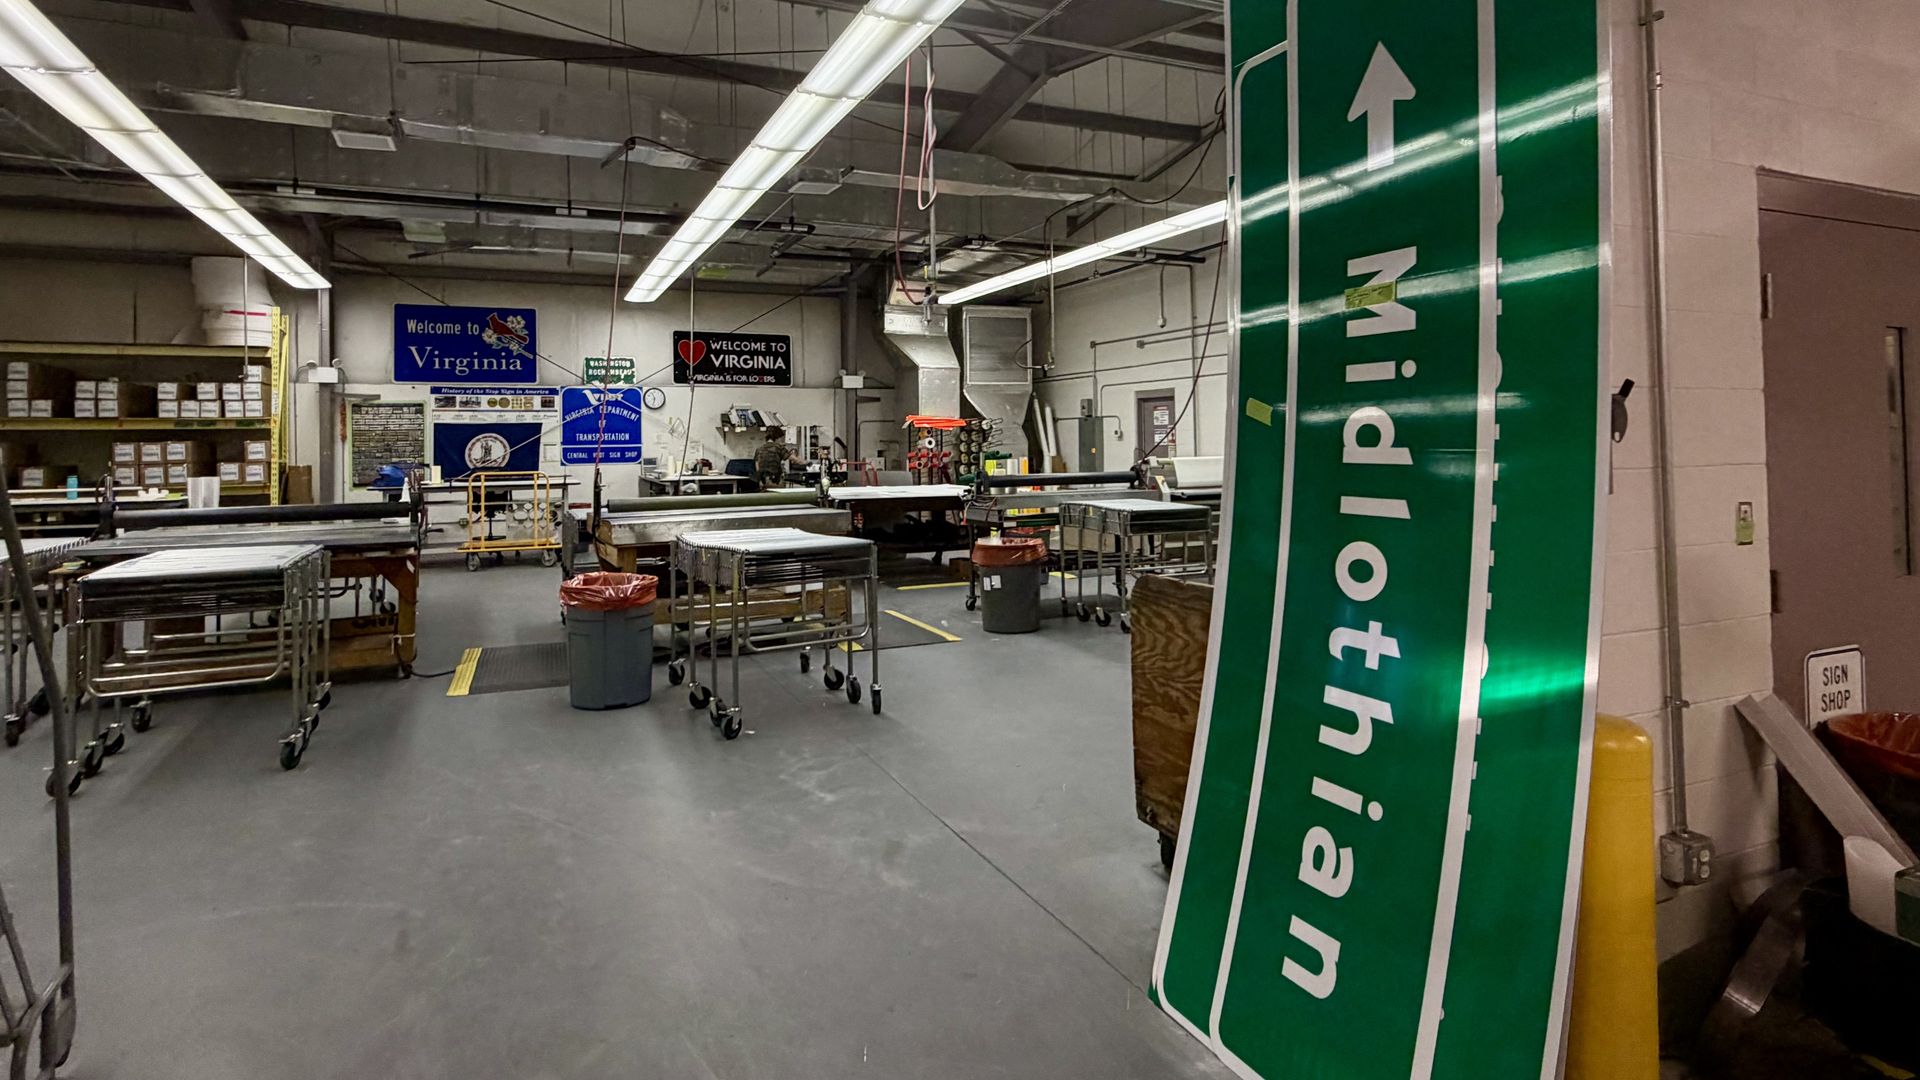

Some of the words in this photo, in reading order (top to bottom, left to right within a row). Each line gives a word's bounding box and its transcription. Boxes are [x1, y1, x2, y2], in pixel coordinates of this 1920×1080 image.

[406, 319, 461, 335] Welcome
[467, 321, 480, 336] to
[710, 340, 766, 351] WELCOME
[770, 342, 787, 352] TO
[408, 346, 523, 376] Virginia
[710, 354, 786, 369] VIRGINIA
[725, 374, 732, 382] IS
[441, 387, 464, 395] History
[599, 405, 640, 422] DEPARTMENT
[576, 433, 630, 441] TRANSPORTATION
[1281, 246, 1417, 1000] Midlothian
[1822, 664, 1849, 687] SIGN
[1821, 689, 1851, 713] SHOP
